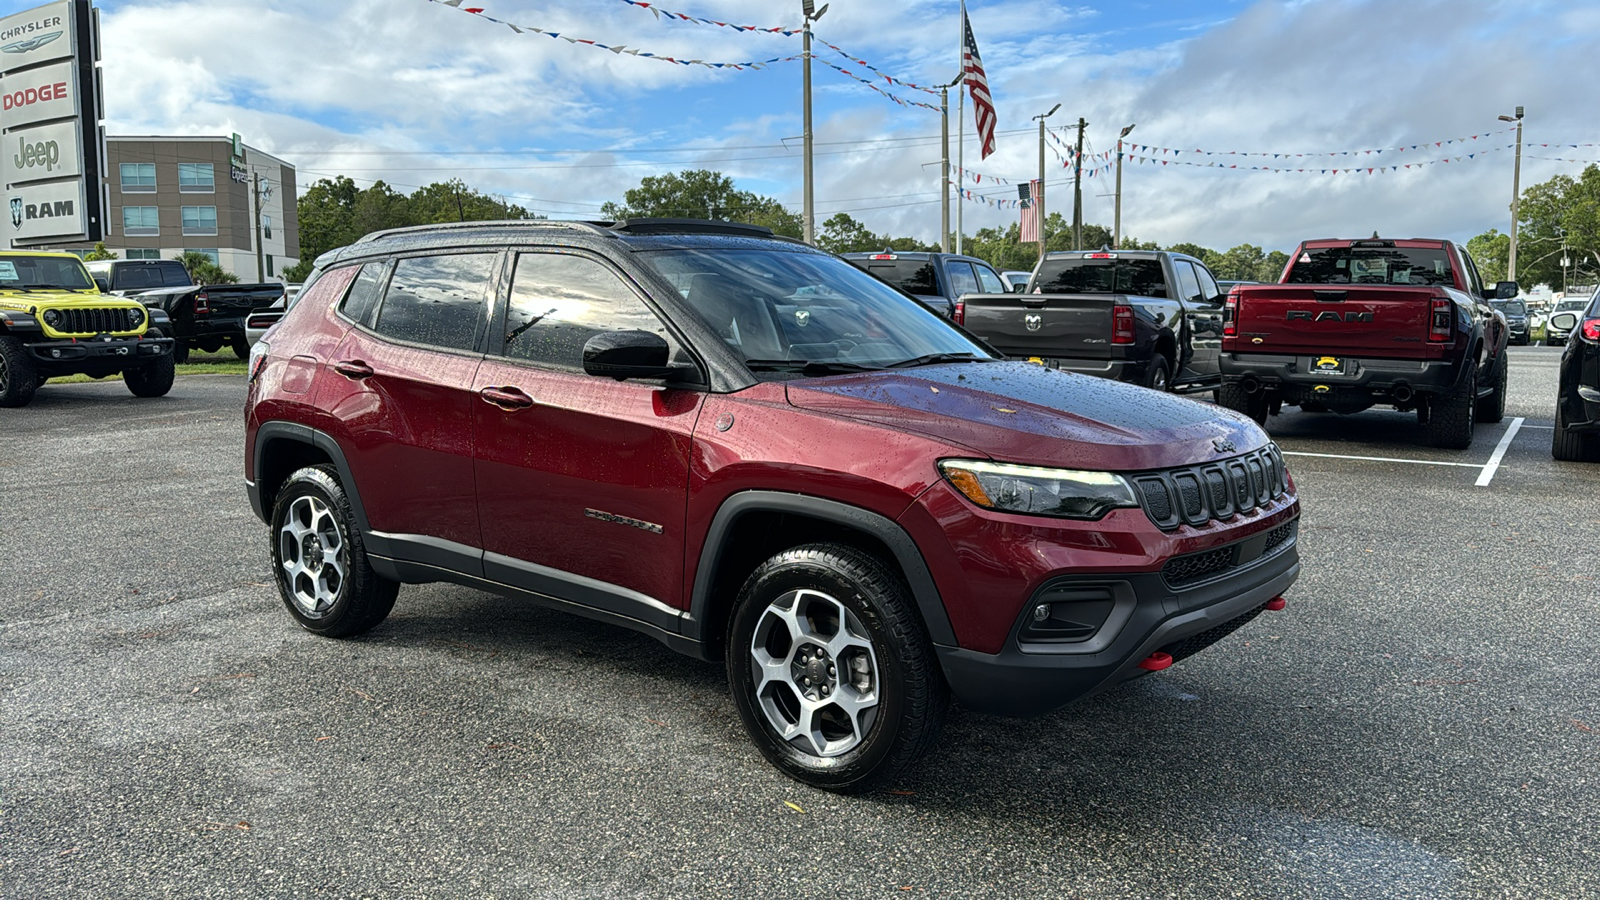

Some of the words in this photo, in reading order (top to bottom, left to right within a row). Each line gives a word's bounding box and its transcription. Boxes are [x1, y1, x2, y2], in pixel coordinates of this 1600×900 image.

[1, 16, 61, 41] CHRYSLER
[3, 82, 67, 110] DODGE
[14, 136, 59, 172] Jeep
[25, 200, 74, 220] RAM
[1286, 310, 1374, 323] RAM
[1212, 439, 1237, 453] Jeep
